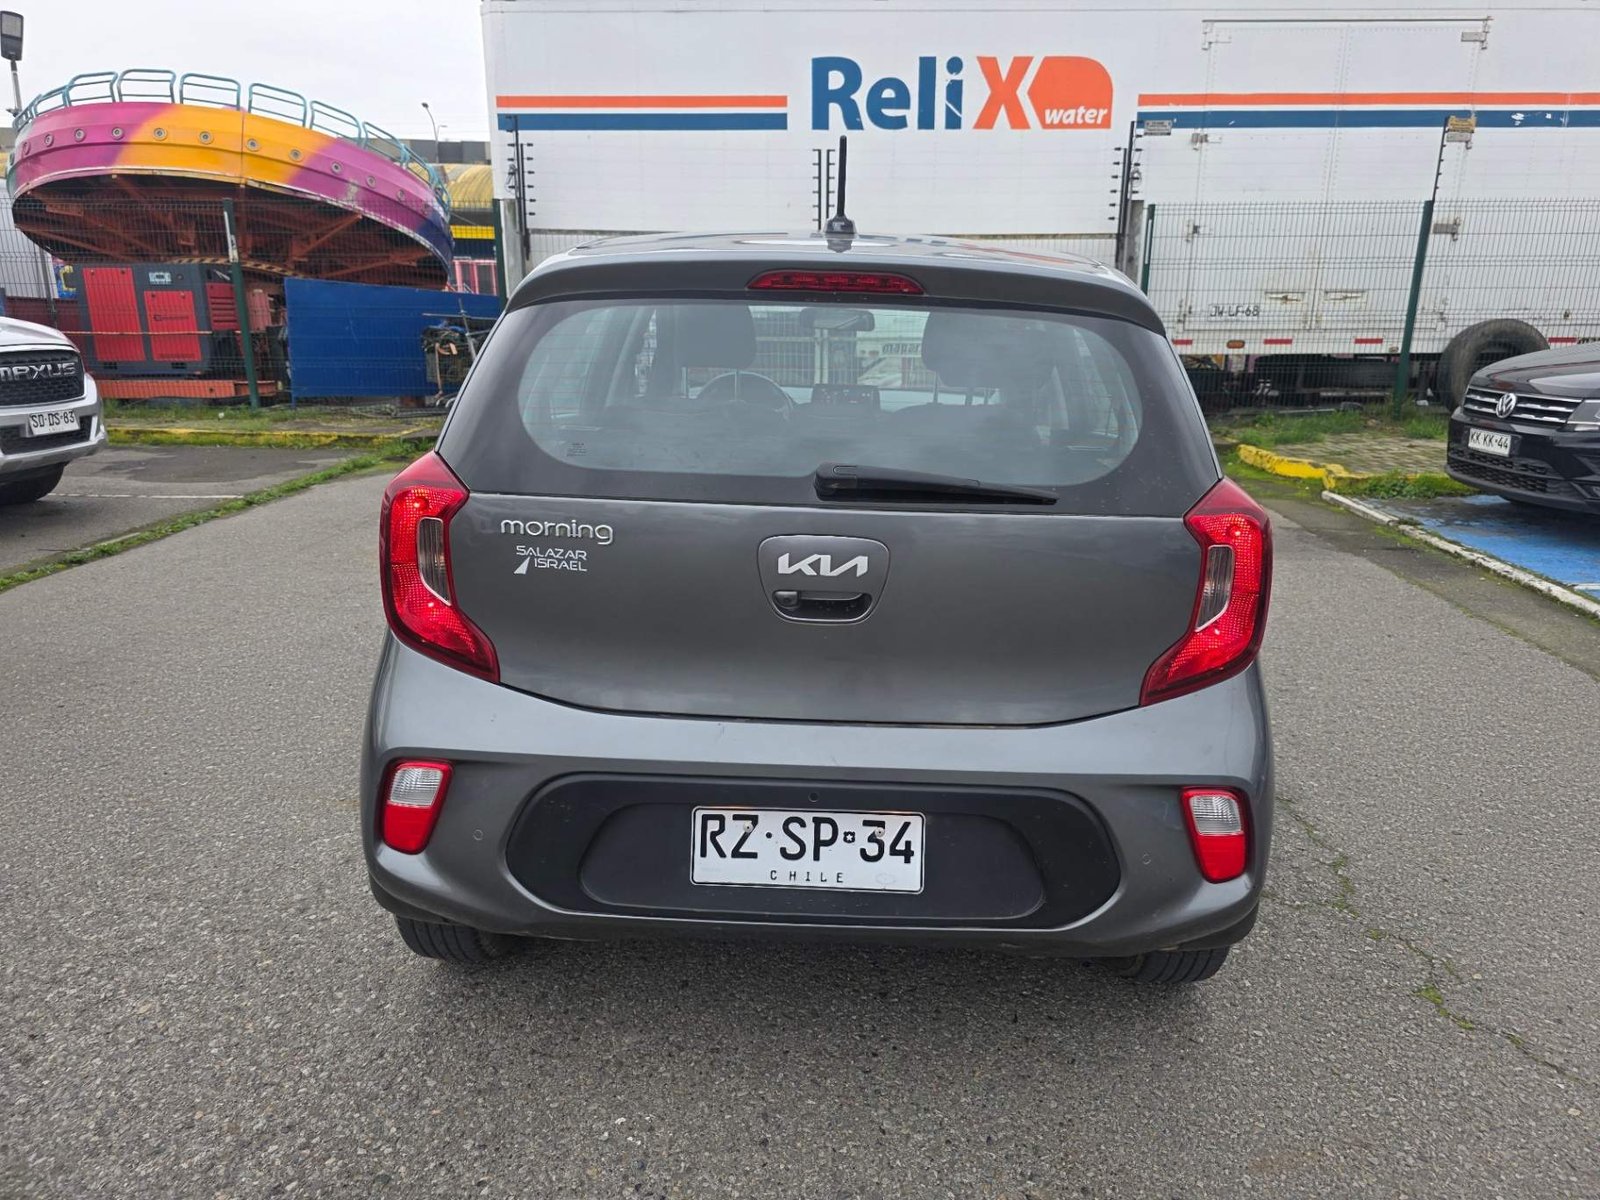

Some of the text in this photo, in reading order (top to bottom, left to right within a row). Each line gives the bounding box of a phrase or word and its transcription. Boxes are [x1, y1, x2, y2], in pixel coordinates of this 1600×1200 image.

[1044, 105, 1109, 125] water
[500, 519, 613, 545] morning
[516, 545, 588, 561] SALAZAR
[534, 558, 588, 572] ISRAEL
[778, 552, 869, 577] KIA
[770, 869, 844, 884] CHILE
